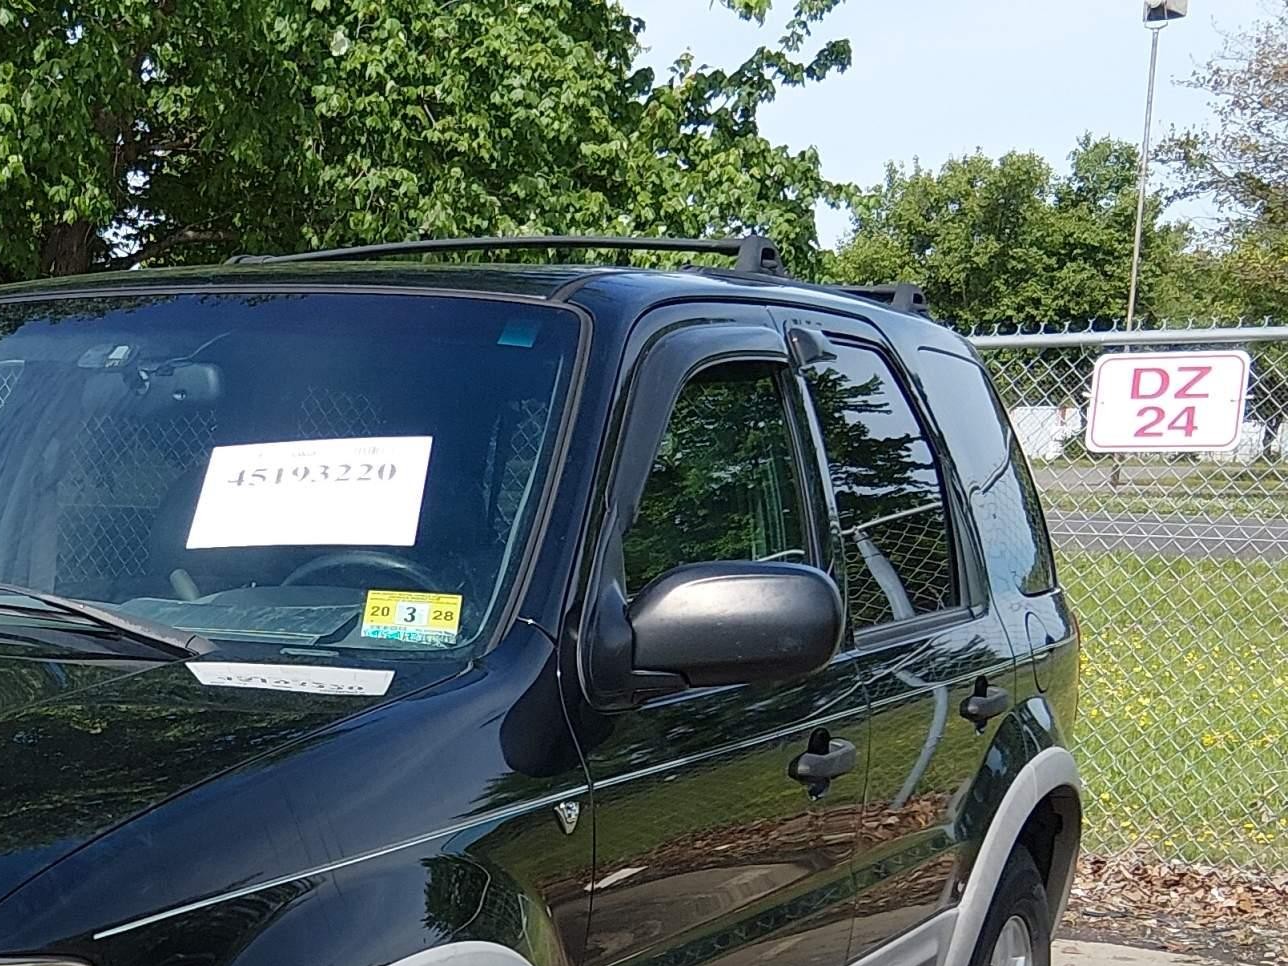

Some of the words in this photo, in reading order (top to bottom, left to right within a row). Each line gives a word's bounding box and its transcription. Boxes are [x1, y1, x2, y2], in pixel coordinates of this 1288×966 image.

[1130, 366, 1212, 400] DZ
[1133, 406, 1198, 437] 24
[227, 463, 397, 487] 45193220
[370, 605, 390, 617] 20
[403, 606, 417, 623] 3
[432, 610, 454, 621] 28
